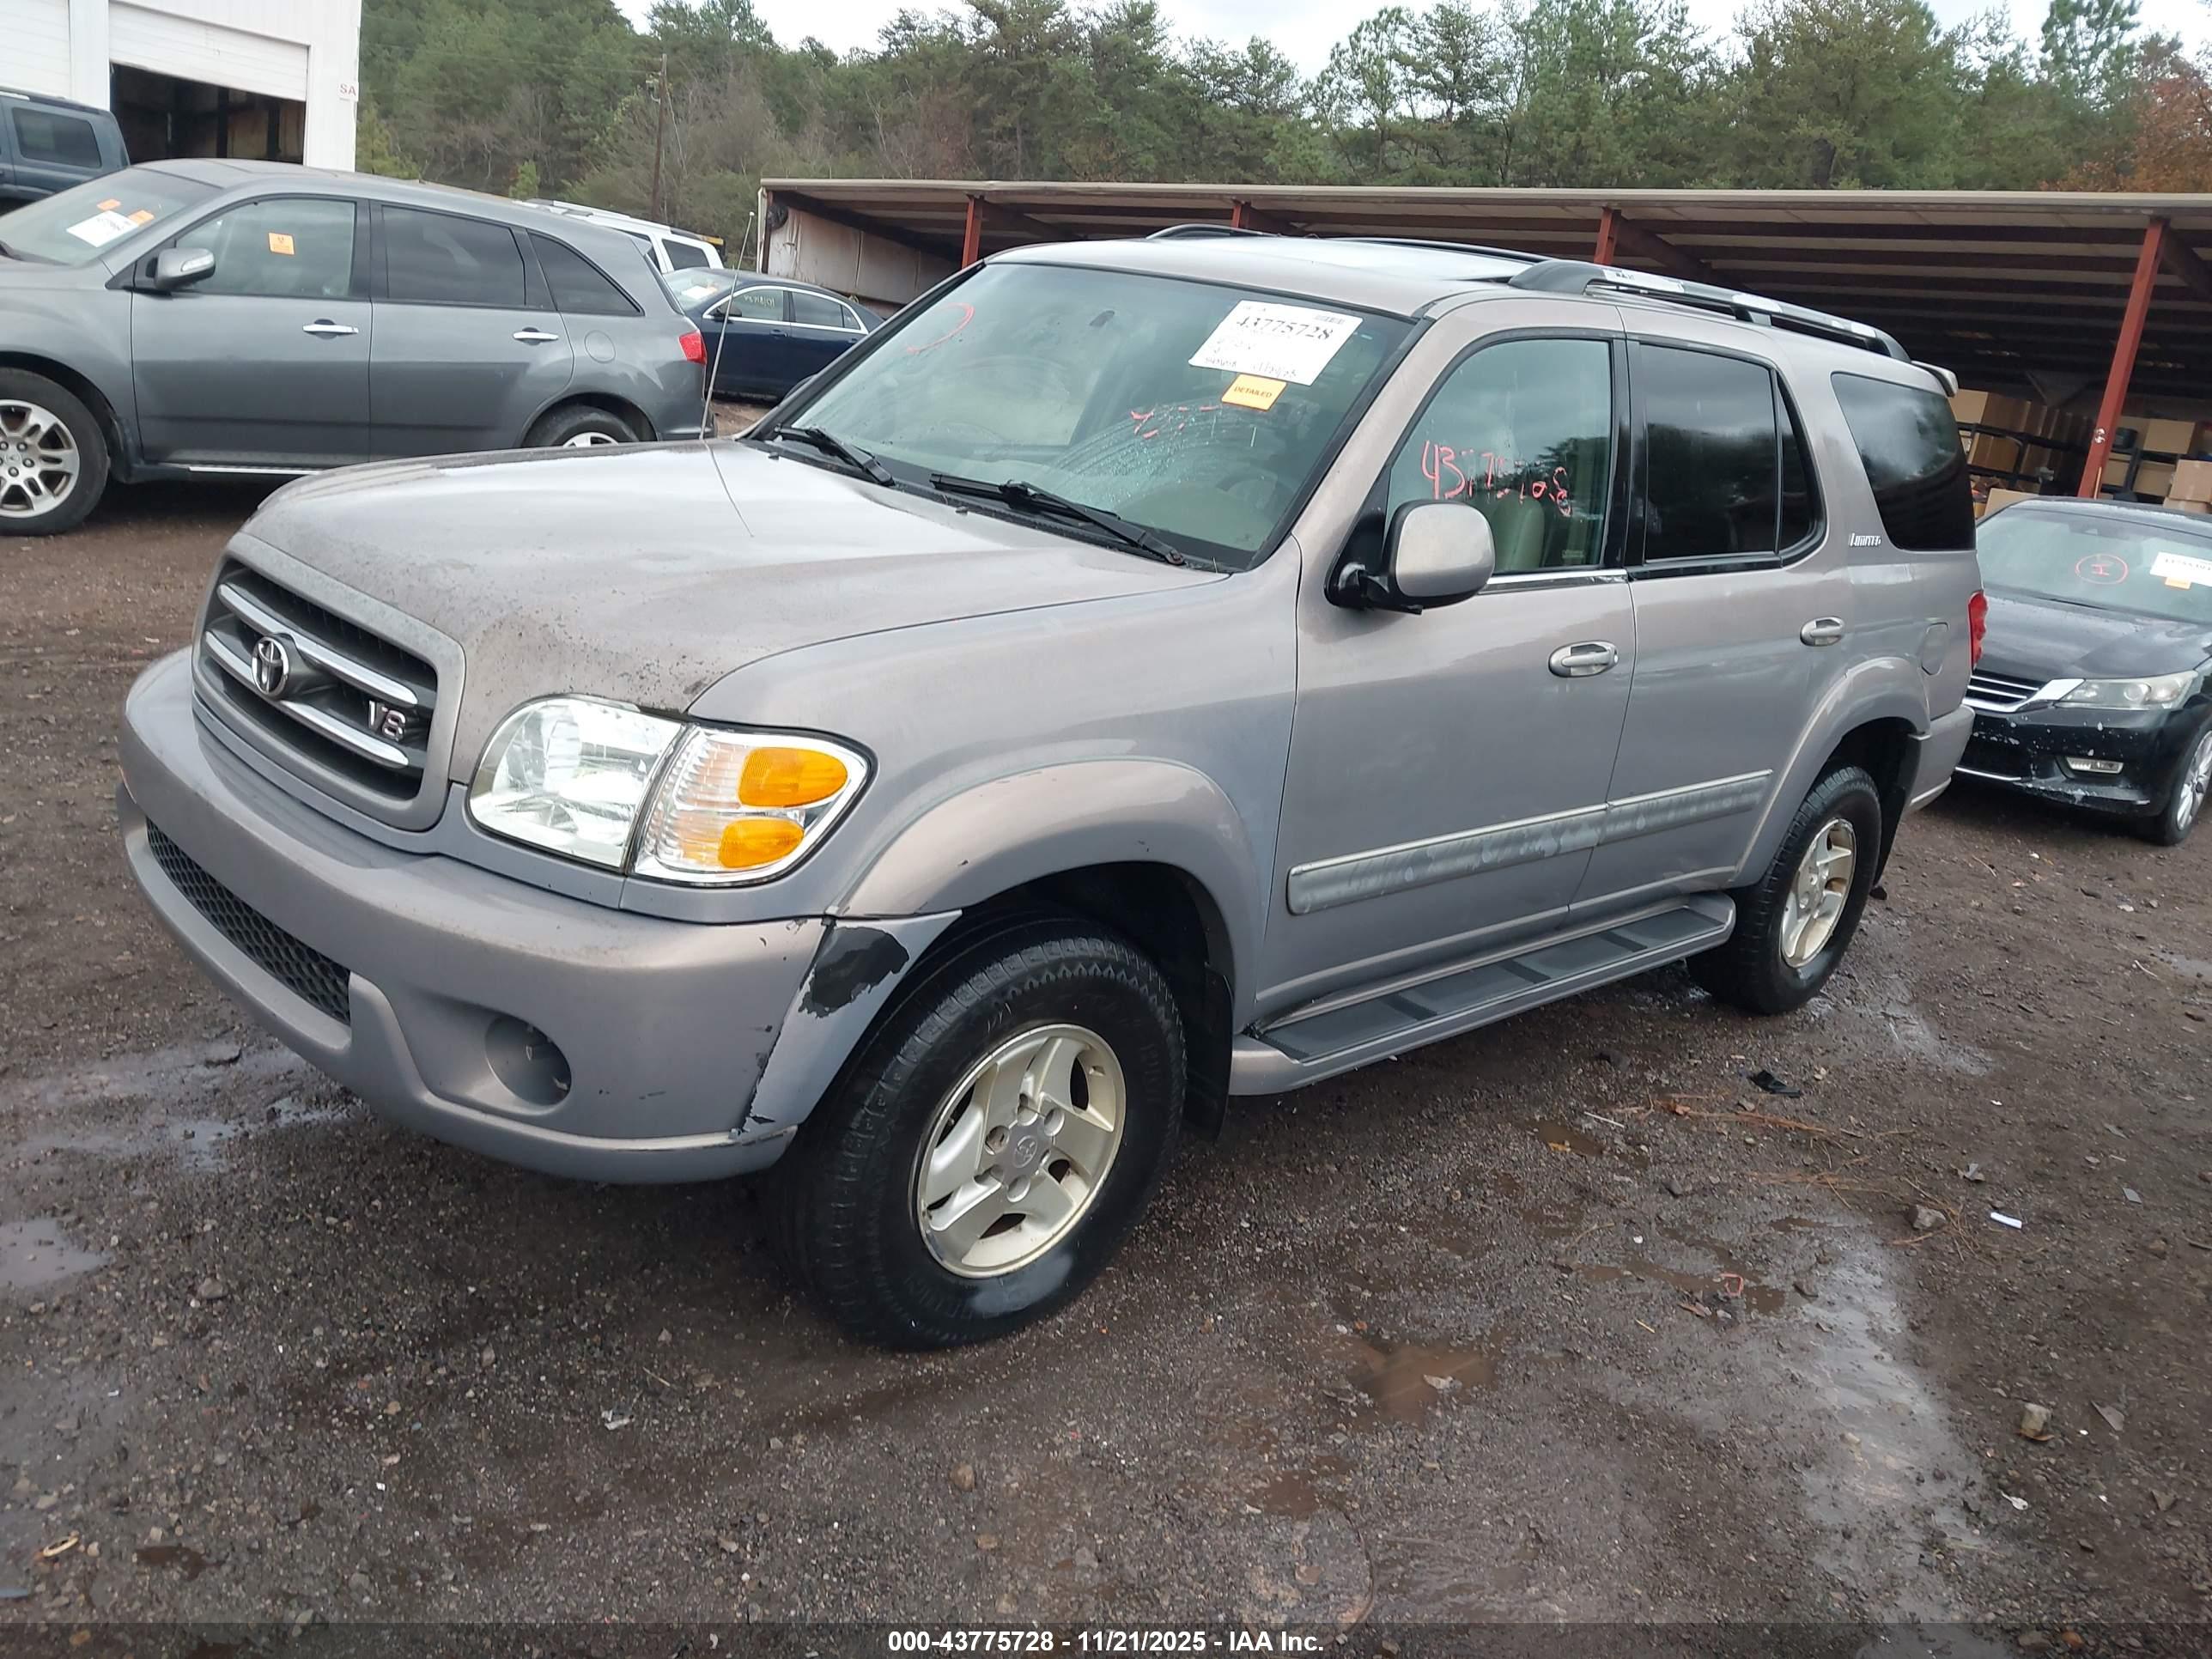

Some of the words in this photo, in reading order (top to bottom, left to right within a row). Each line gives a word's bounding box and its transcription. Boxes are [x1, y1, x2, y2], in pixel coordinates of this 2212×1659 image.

[339, 83, 356, 96] SA
[1237, 315, 1334, 340] 43775728
[1233, 386, 1273, 398] DETAILED
